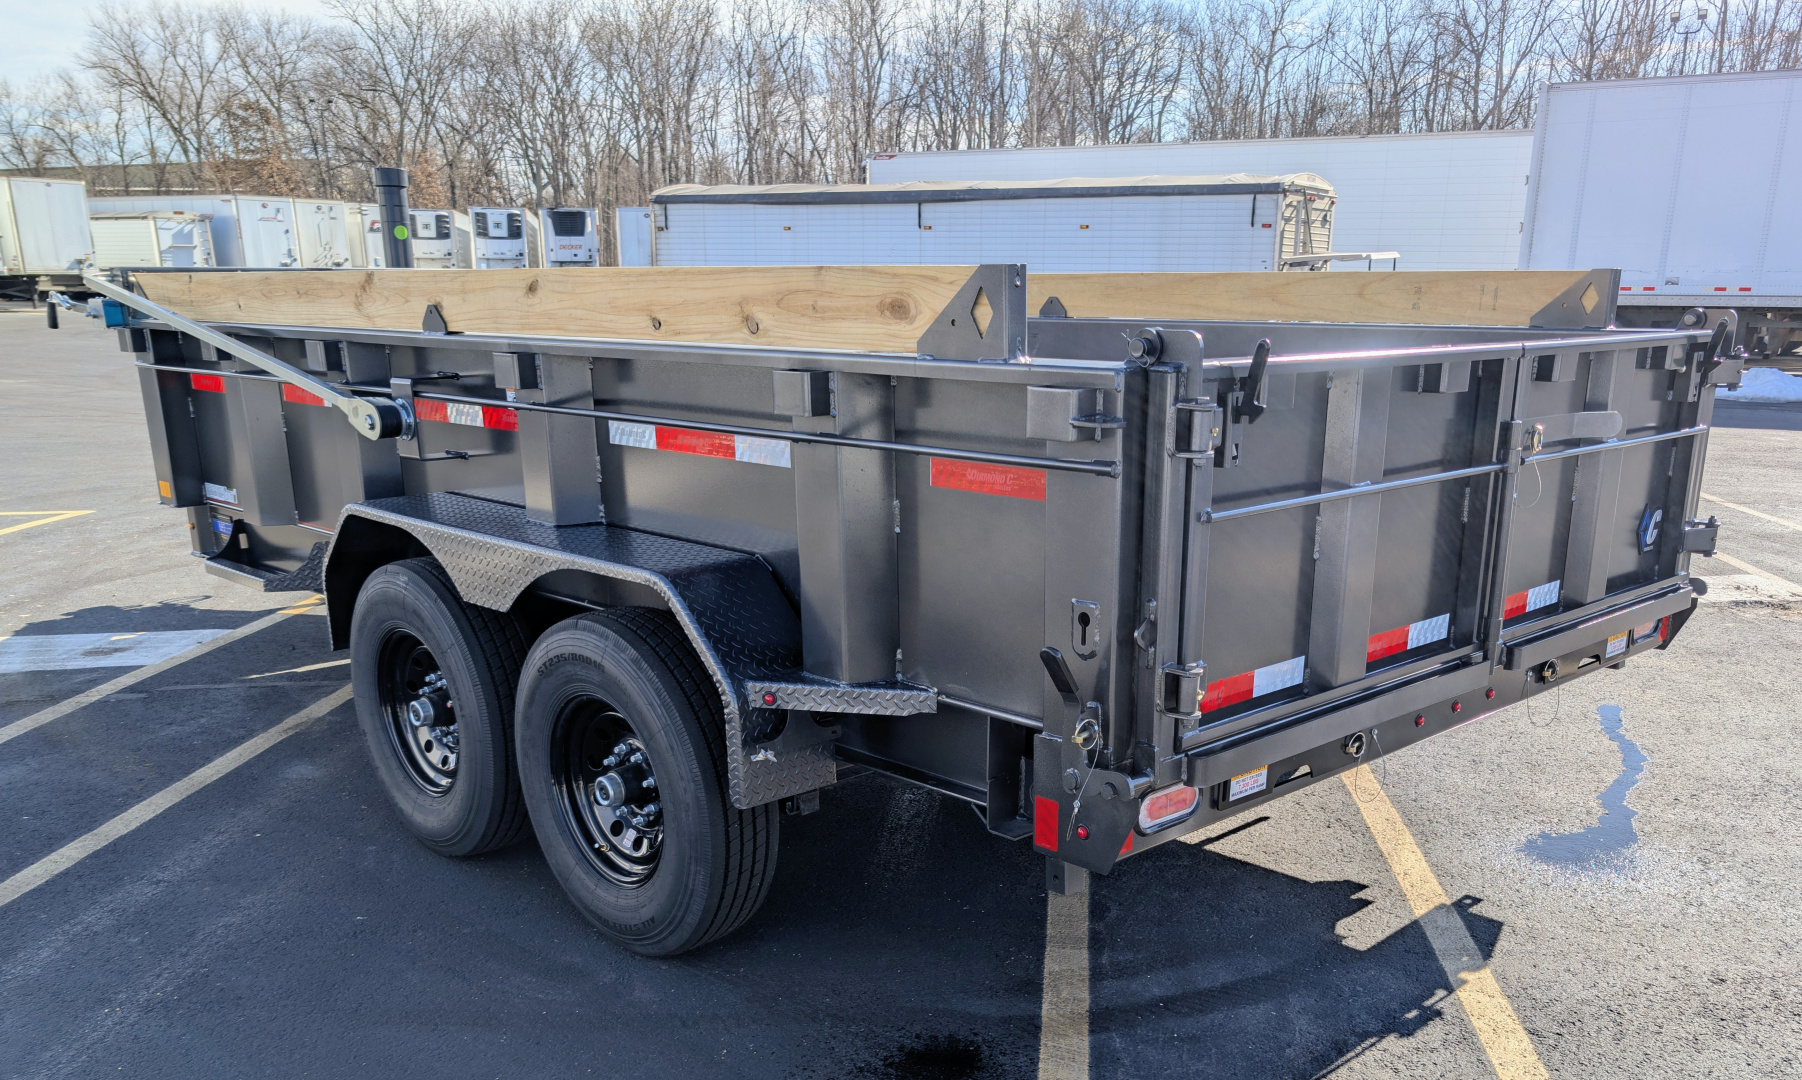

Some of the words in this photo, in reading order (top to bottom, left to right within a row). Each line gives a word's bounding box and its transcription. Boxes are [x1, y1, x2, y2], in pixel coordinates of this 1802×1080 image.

[971, 469, 1005, 484] DIAMOND
[1007, 473, 1014, 485] C
[1646, 509, 1662, 545] C
